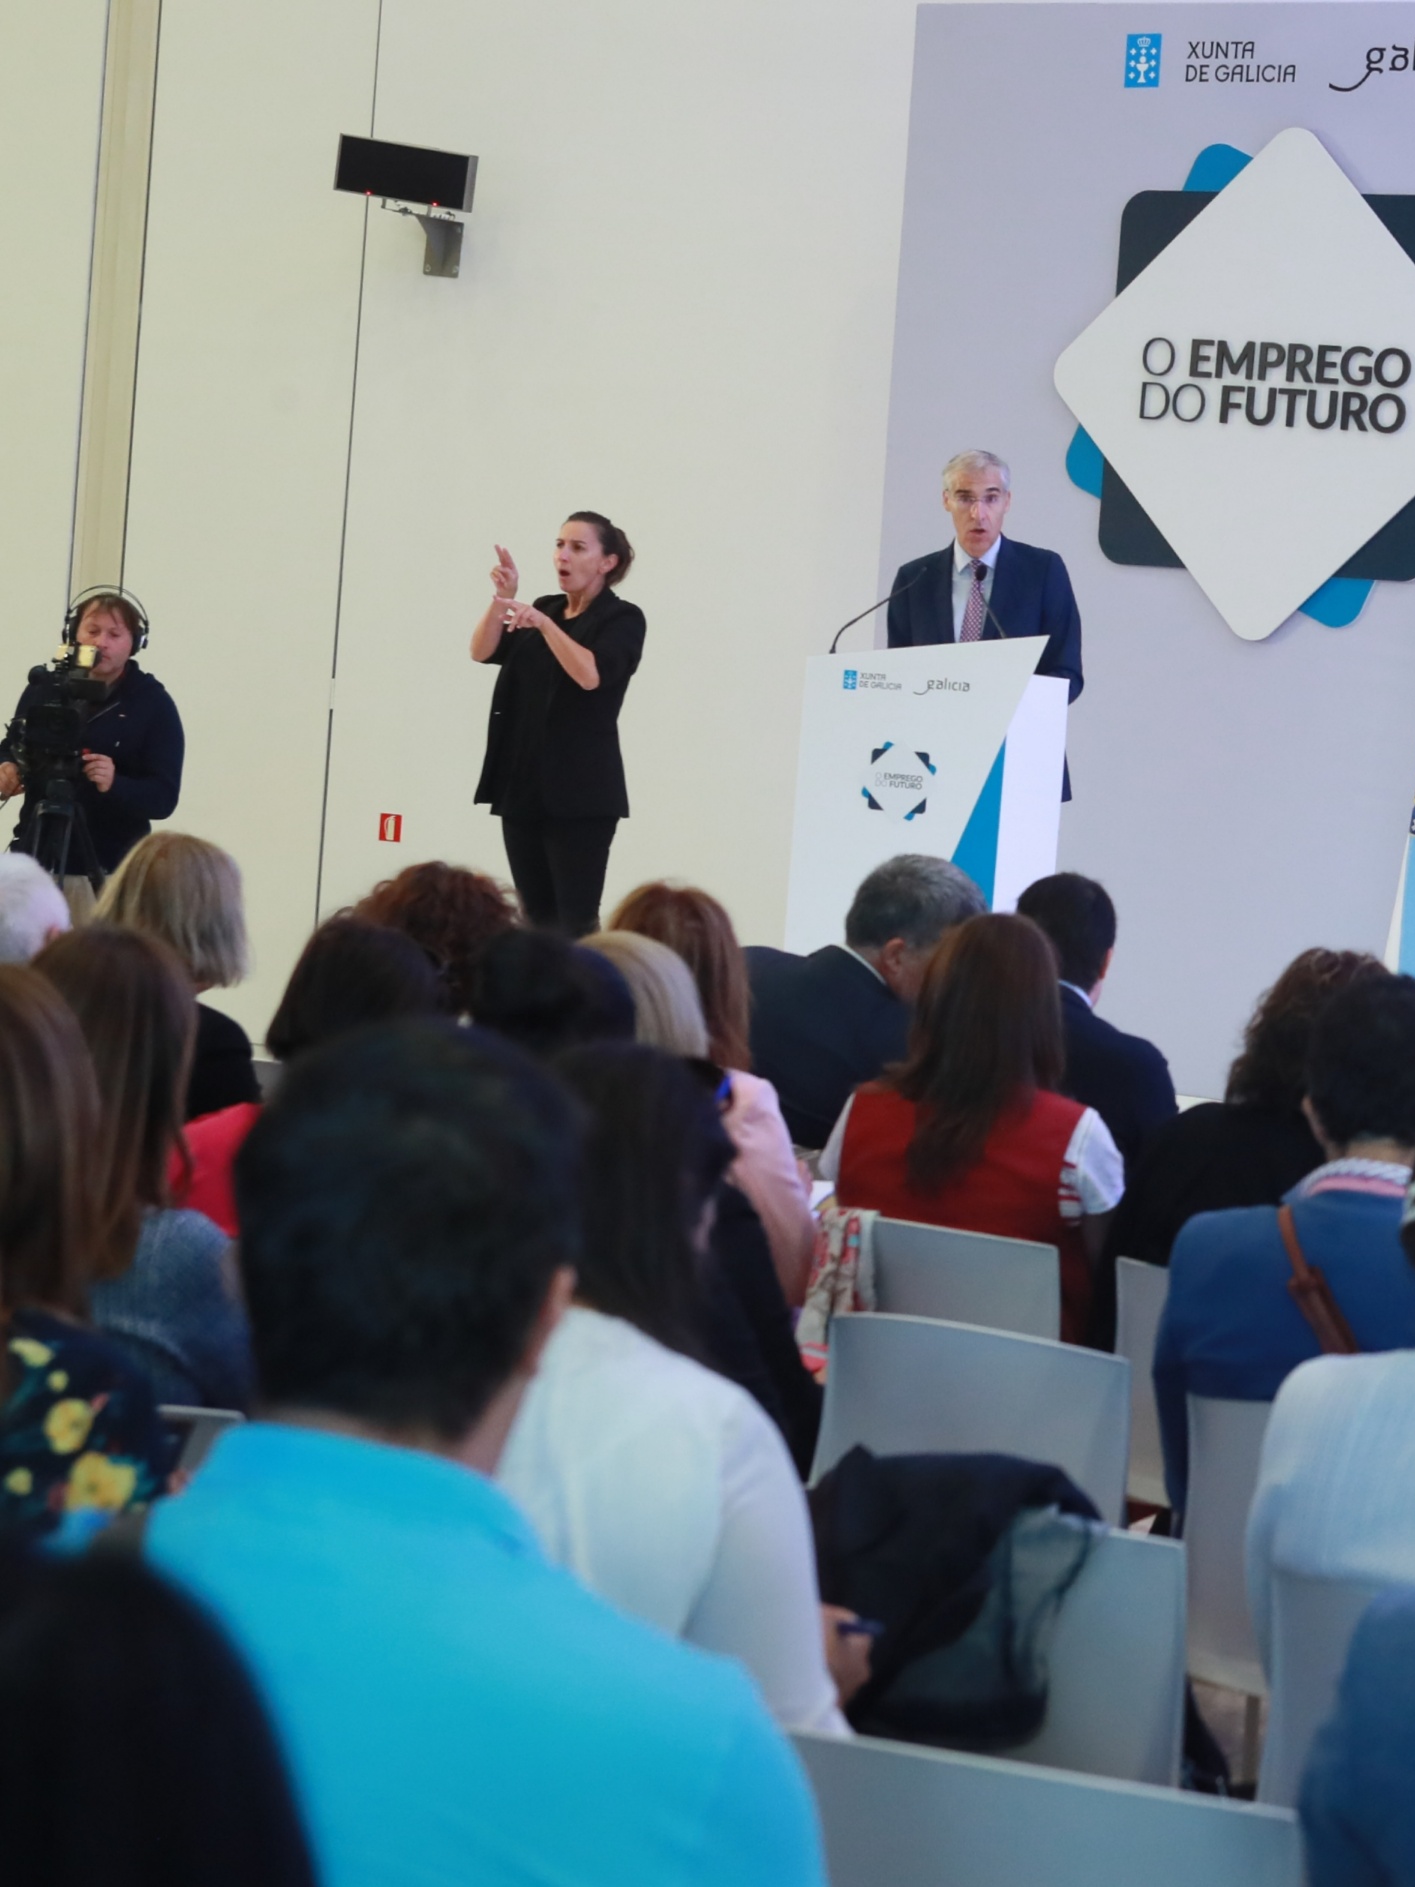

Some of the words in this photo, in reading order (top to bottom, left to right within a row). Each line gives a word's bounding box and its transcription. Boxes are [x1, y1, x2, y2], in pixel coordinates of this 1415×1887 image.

[1187, 41, 1255, 60] XUNTA
[1184, 64, 1209, 83] DE
[1215, 64, 1297, 84] GALICIA
[1142, 337, 1176, 376] O
[1188, 338, 1412, 388] EMPREGO
[1139, 381, 1206, 422] DO
[1219, 385, 1407, 434] FUTURO
[859, 680, 869, 688] DE
[870, 681, 902, 690] GALICIA
[860, 672, 886, 680] XUNTA
[913, 677, 970, 695] galicia
[883, 772, 923, 783] EMPREGO
[889, 780, 922, 790] FUTURO
